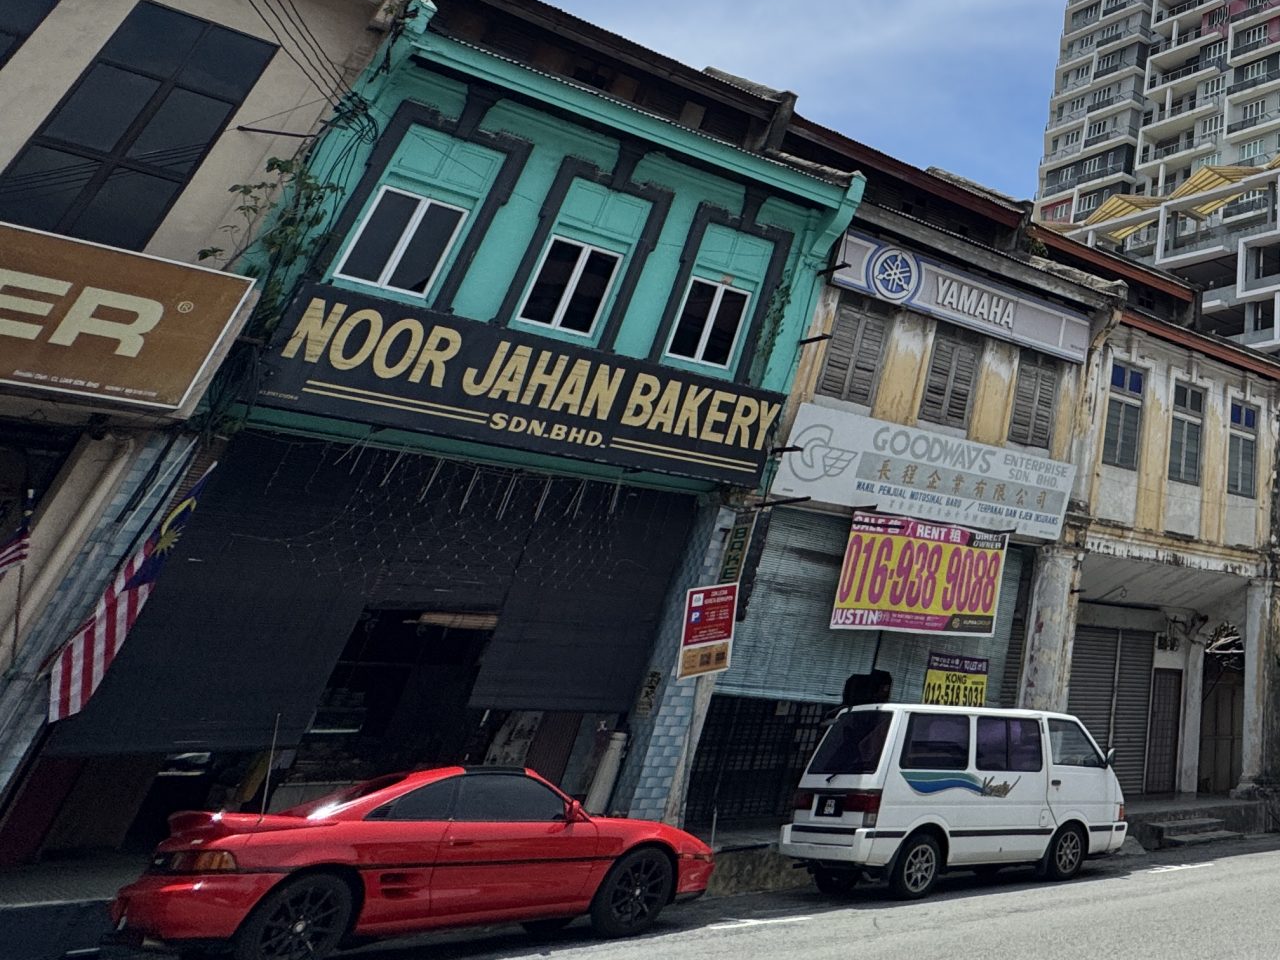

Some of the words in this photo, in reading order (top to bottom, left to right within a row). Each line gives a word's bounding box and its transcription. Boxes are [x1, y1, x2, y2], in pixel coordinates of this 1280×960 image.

[935, 276, 1015, 329] YAMAHA
[281, 297, 463, 388] NOOR
[462, 340, 626, 421] JAHAN
[620, 373, 782, 451] BAKERY
[872, 426, 997, 474] GOODWAYS
[1003, 453, 1069, 478] ENTERPRISE
[877, 459, 1047, 509] 長程企業有限公司
[719, 527, 748, 584] BAKE
[915, 524, 948, 541] RENT
[838, 533, 943, 610] 016-938
[941, 546, 1001, 614] 9088
[831, 608, 879, 626] JUSTIN
[944, 673, 967, 685] KONG
